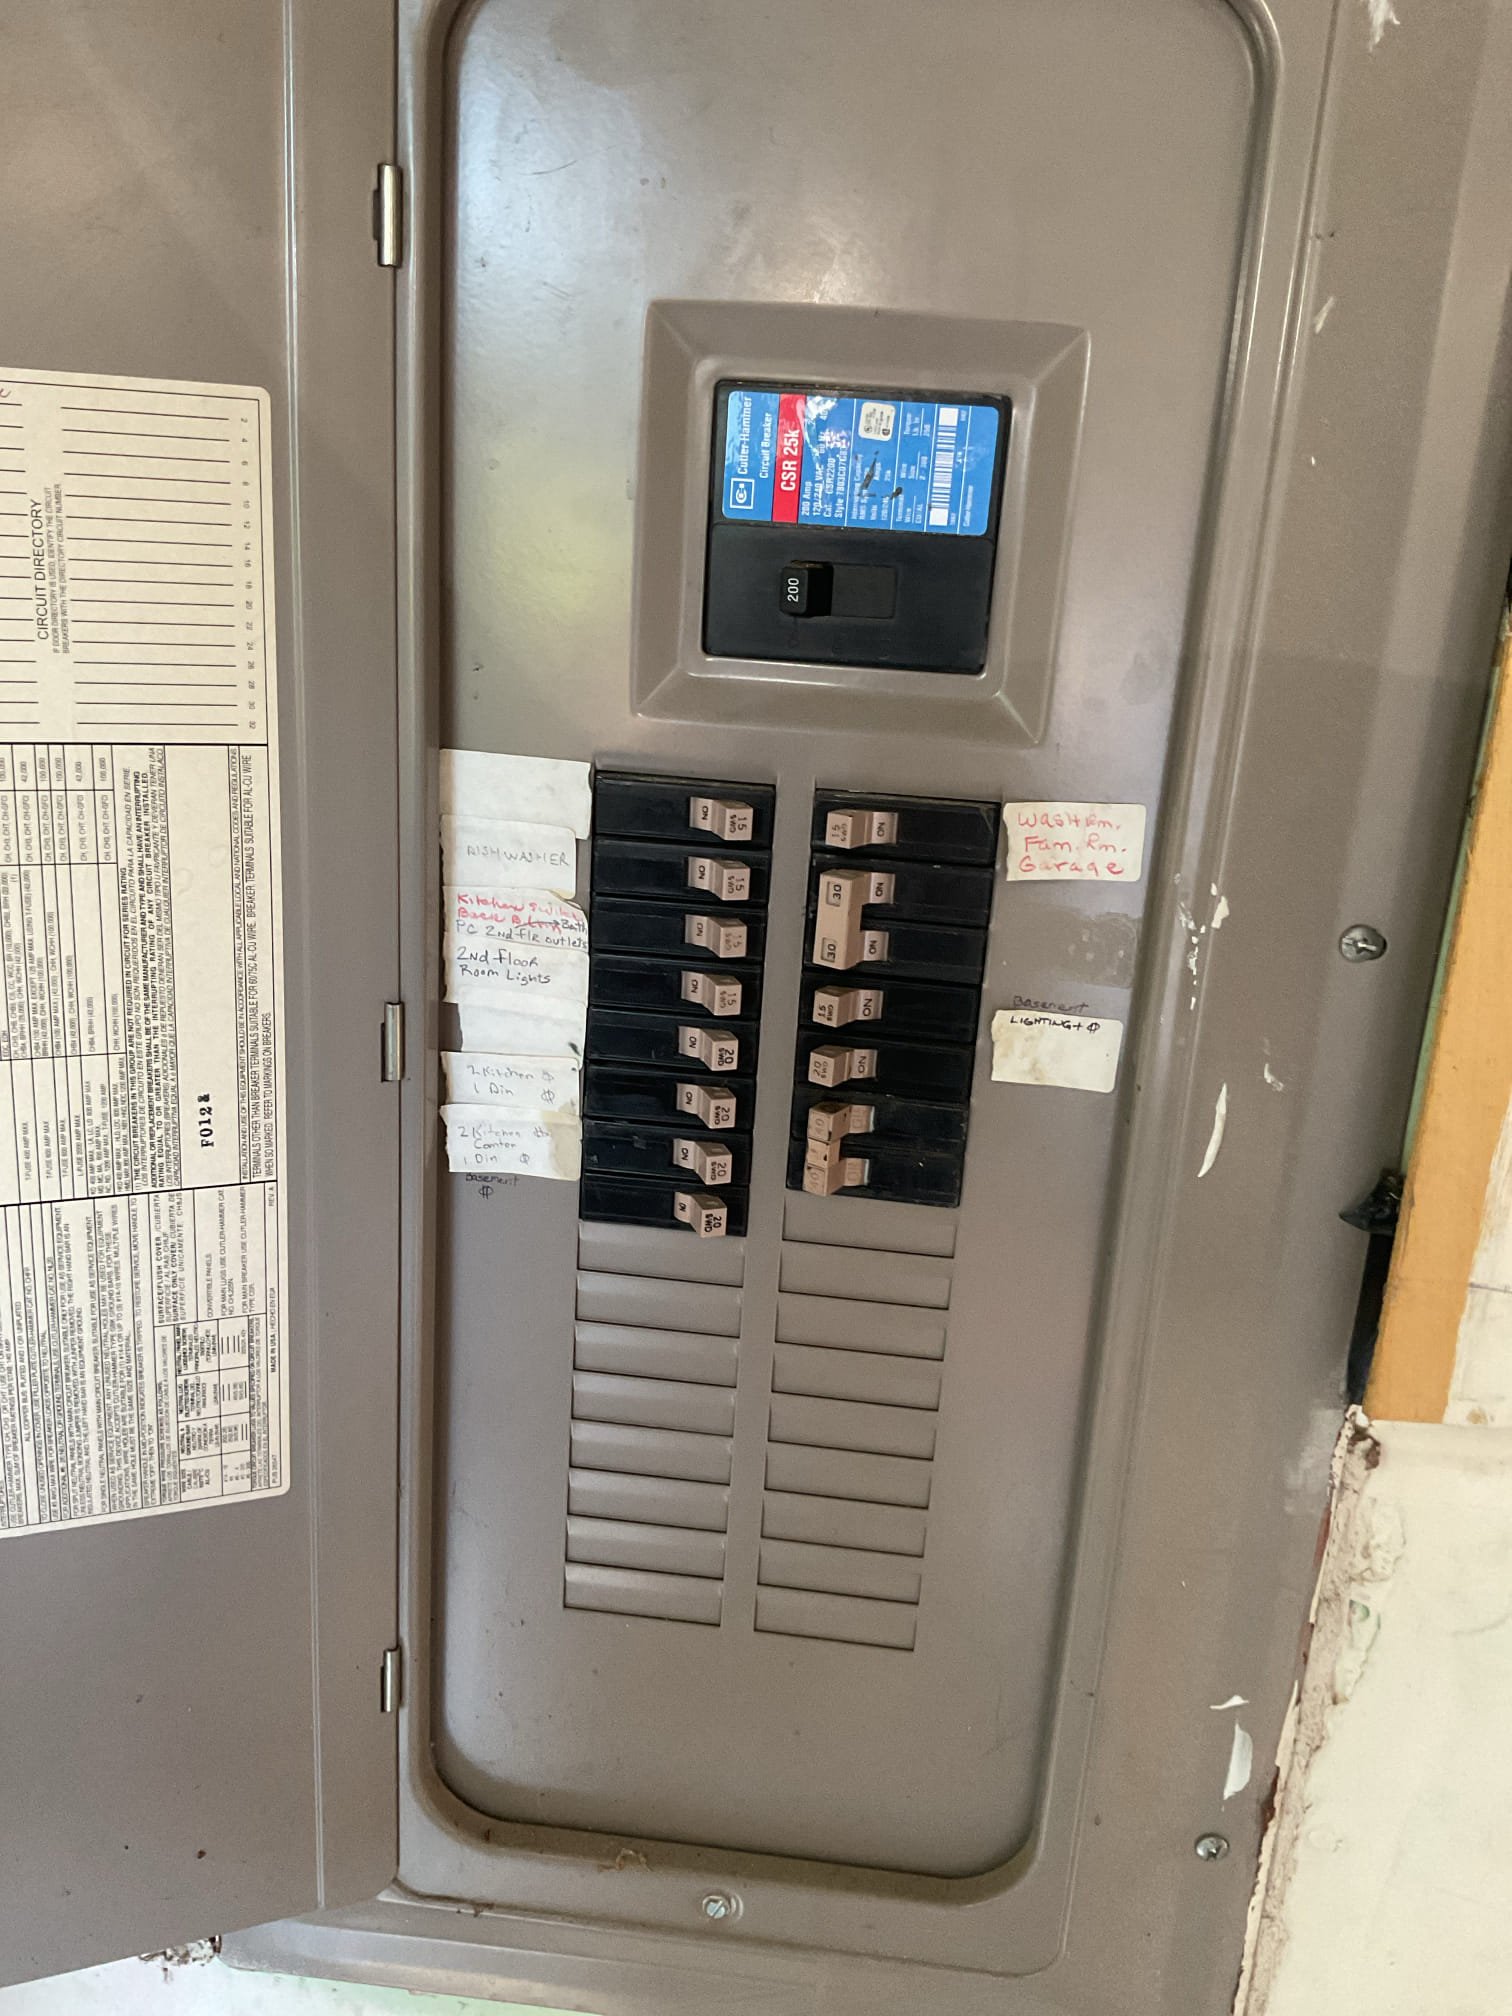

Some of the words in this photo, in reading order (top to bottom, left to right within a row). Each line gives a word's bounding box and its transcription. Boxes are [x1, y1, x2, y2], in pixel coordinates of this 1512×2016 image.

[737, 396, 752, 474] Cutler-Hammer
[760, 412, 772, 448] Breaker
[782, 429, 800, 456] 25k
[760, 449, 770, 478] Circuit
[780, 460, 798, 491] CSR
[803, 480, 812, 499] Amp
[54, 484, 62, 513] NUMBER
[801, 502, 810, 516] 200
[834, 498, 844, 518] Style
[56, 515, 64, 542] CIRCUIT
[30, 498, 46, 581] DIRECTORY
[58, 544, 66, 583] DIRECTORY
[787, 578, 799, 602] 200
[34, 584, 49, 640] CIRCUIT
[60, 599, 68, 616] WITH
[61, 618, 70, 654] BREAKERS
[242, 755, 251, 773] WIRE
[243, 776, 252, 796] AL-CU
[243, 798, 253, 812] FOR
[702, 806, 708, 820] ON
[244, 814, 254, 844] SUITABLE
[738, 816, 748, 830] 15
[832, 824, 840, 837] 15
[877, 822, 885, 836] ON
[245, 846, 255, 882] TERMINALS
[1020, 856, 1124, 878] Garage
[698, 865, 706, 880] ON
[736, 878, 745, 891] 15
[833, 884, 842, 900] 30
[876, 882, 883, 897] ON
[121, 897, 129, 922] SERIES
[696, 922, 704, 936] ON
[545, 936, 588, 948] outlets
[869, 940, 878, 954] ON
[827, 944, 836, 960] 30
[459, 964, 499, 977] Room
[506, 970, 552, 986] Lights
[248, 986, 258, 999] FOR
[691, 979, 698, 993] ON
[125, 980, 133, 1016] REQUIRED
[728, 993, 736, 1006] 15
[818, 1005, 826, 1018] 15
[863, 998, 872, 1016] ON
[248, 1001, 259, 1031] SUITABLE
[689, 1036, 696, 1048] ON
[250, 1032, 260, 1069] TERMINALS
[263, 1047, 272, 1055] ON
[725, 1049, 734, 1064] 20
[813, 1060, 821, 1076] 20
[858, 1055, 866, 1073] ON
[262, 1056, 272, 1089] MARKINGS
[482, 1066, 534, 1080] Kitchen
[250, 1070, 260, 1100] BREAKER
[490, 1082, 514, 1096] Din
[263, 1090, 273, 1098] TO
[686, 1092, 693, 1105] ON
[251, 1102, 260, 1118] THAN
[263, 1099, 273, 1119] REFER
[721, 1107, 730, 1121] 20
[131, 1101, 139, 1138] BREAKERS
[251, 1120, 261, 1141] OTHER
[472, 1124, 521, 1139] Kitchen
[252, 1142, 262, 1178] TERMINALS
[264, 1149, 273, 1157] SO
[475, 1154, 498, 1164] Din
[681, 1148, 688, 1160] ON
[264, 1159, 274, 1176] WHEN
[718, 1163, 727, 1177] 20
[679, 1202, 686, 1212] ON
[713, 1216, 722, 1228] 20
[157, 1265, 165, 1324] SURFACE/FLUSH
